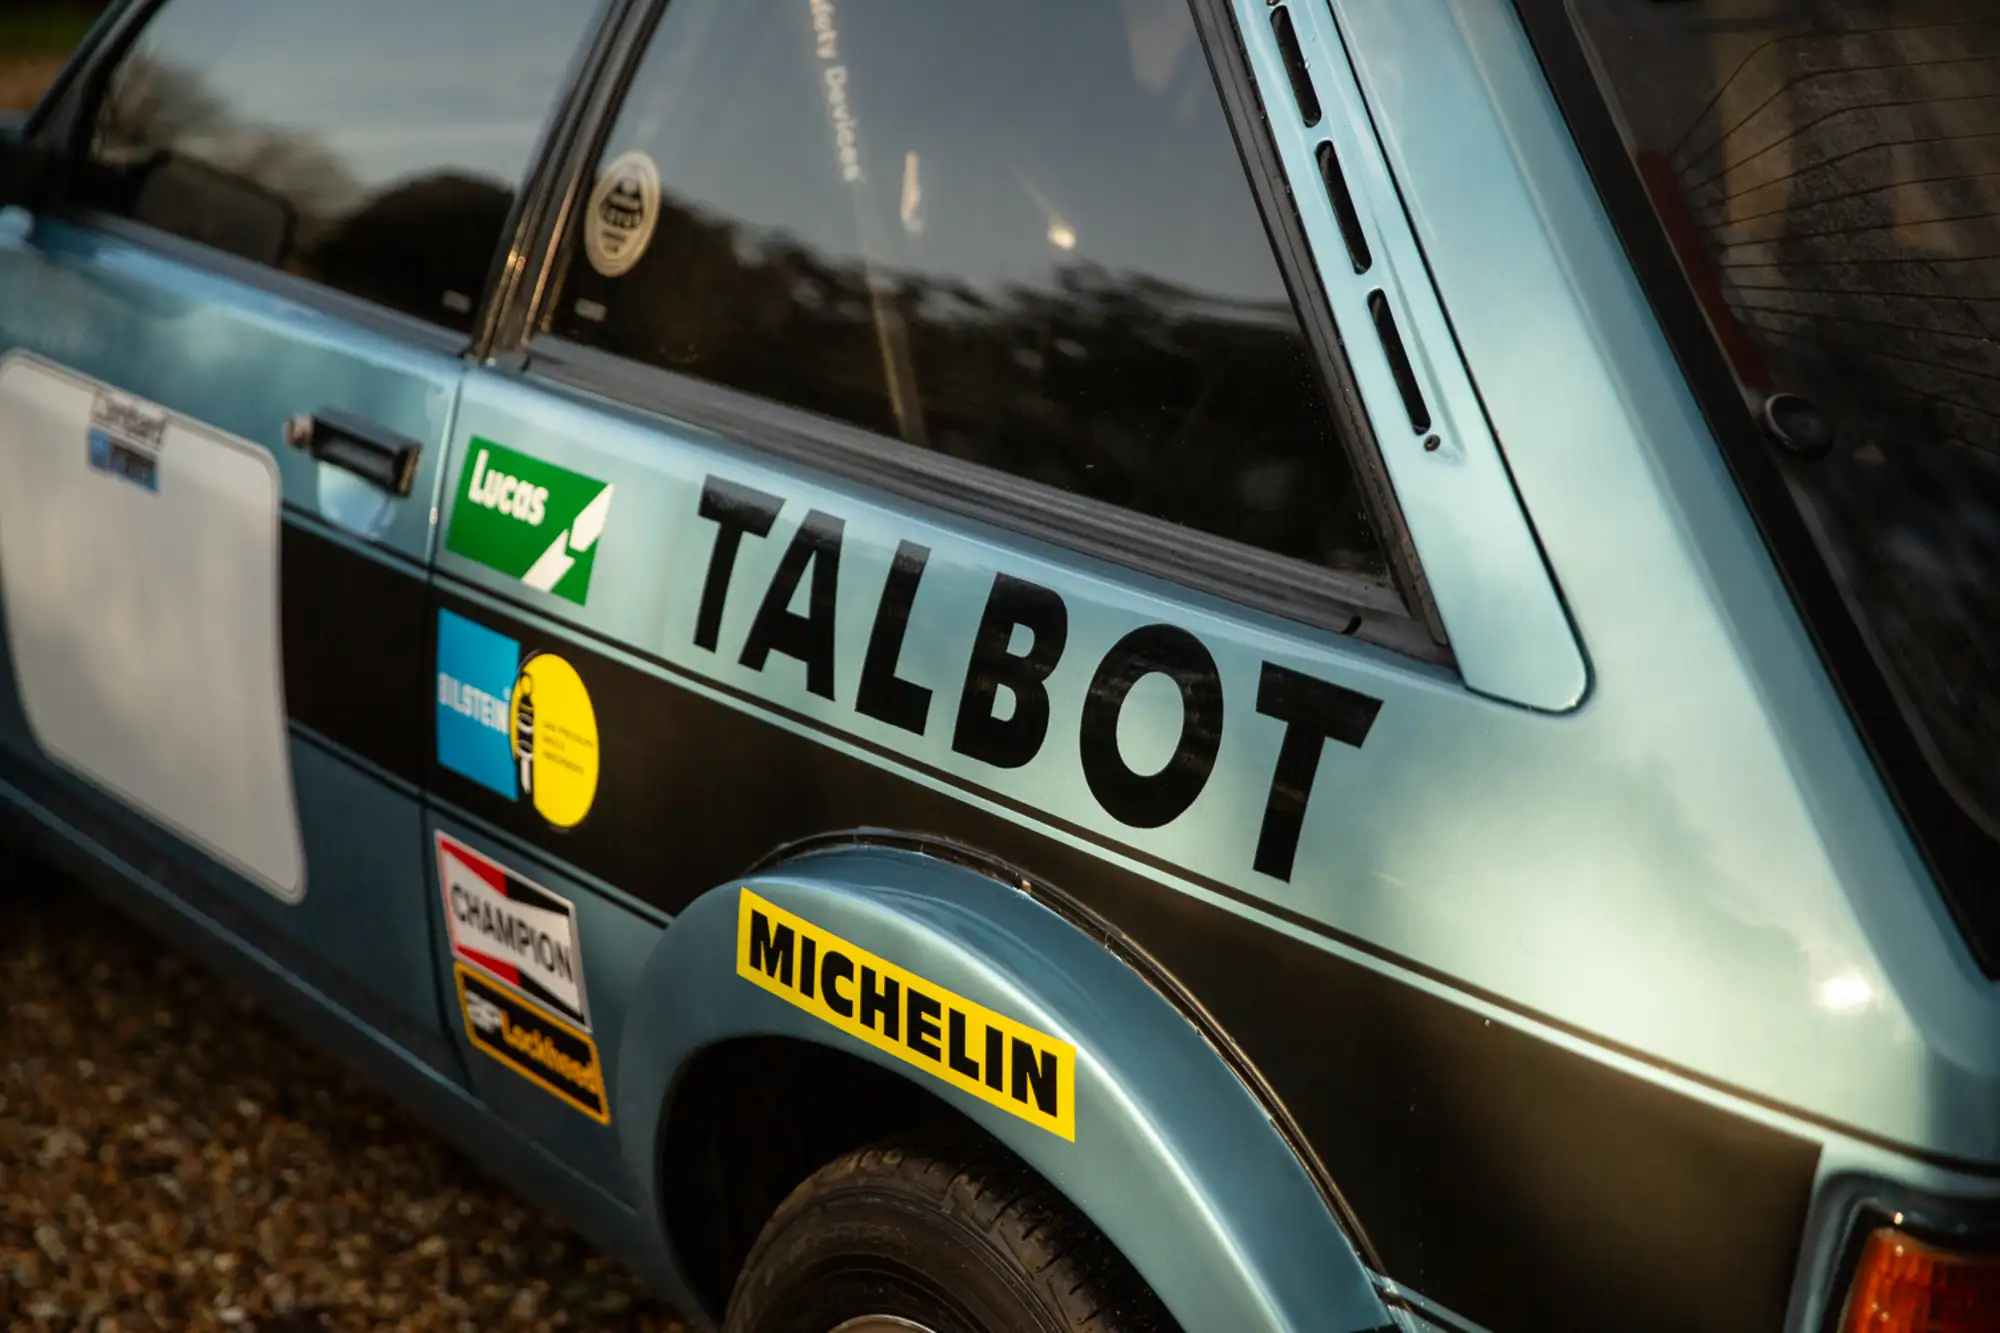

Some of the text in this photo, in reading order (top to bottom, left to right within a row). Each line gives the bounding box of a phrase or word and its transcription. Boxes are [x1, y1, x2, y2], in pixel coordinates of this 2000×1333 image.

[468, 448, 549, 526] Lucas
[437, 671, 509, 735] BILSTEIN
[692, 473, 1384, 884] TALBOT
[450, 881, 573, 983] CHAMPION
[749, 909, 1057, 1118] MICHELIN
